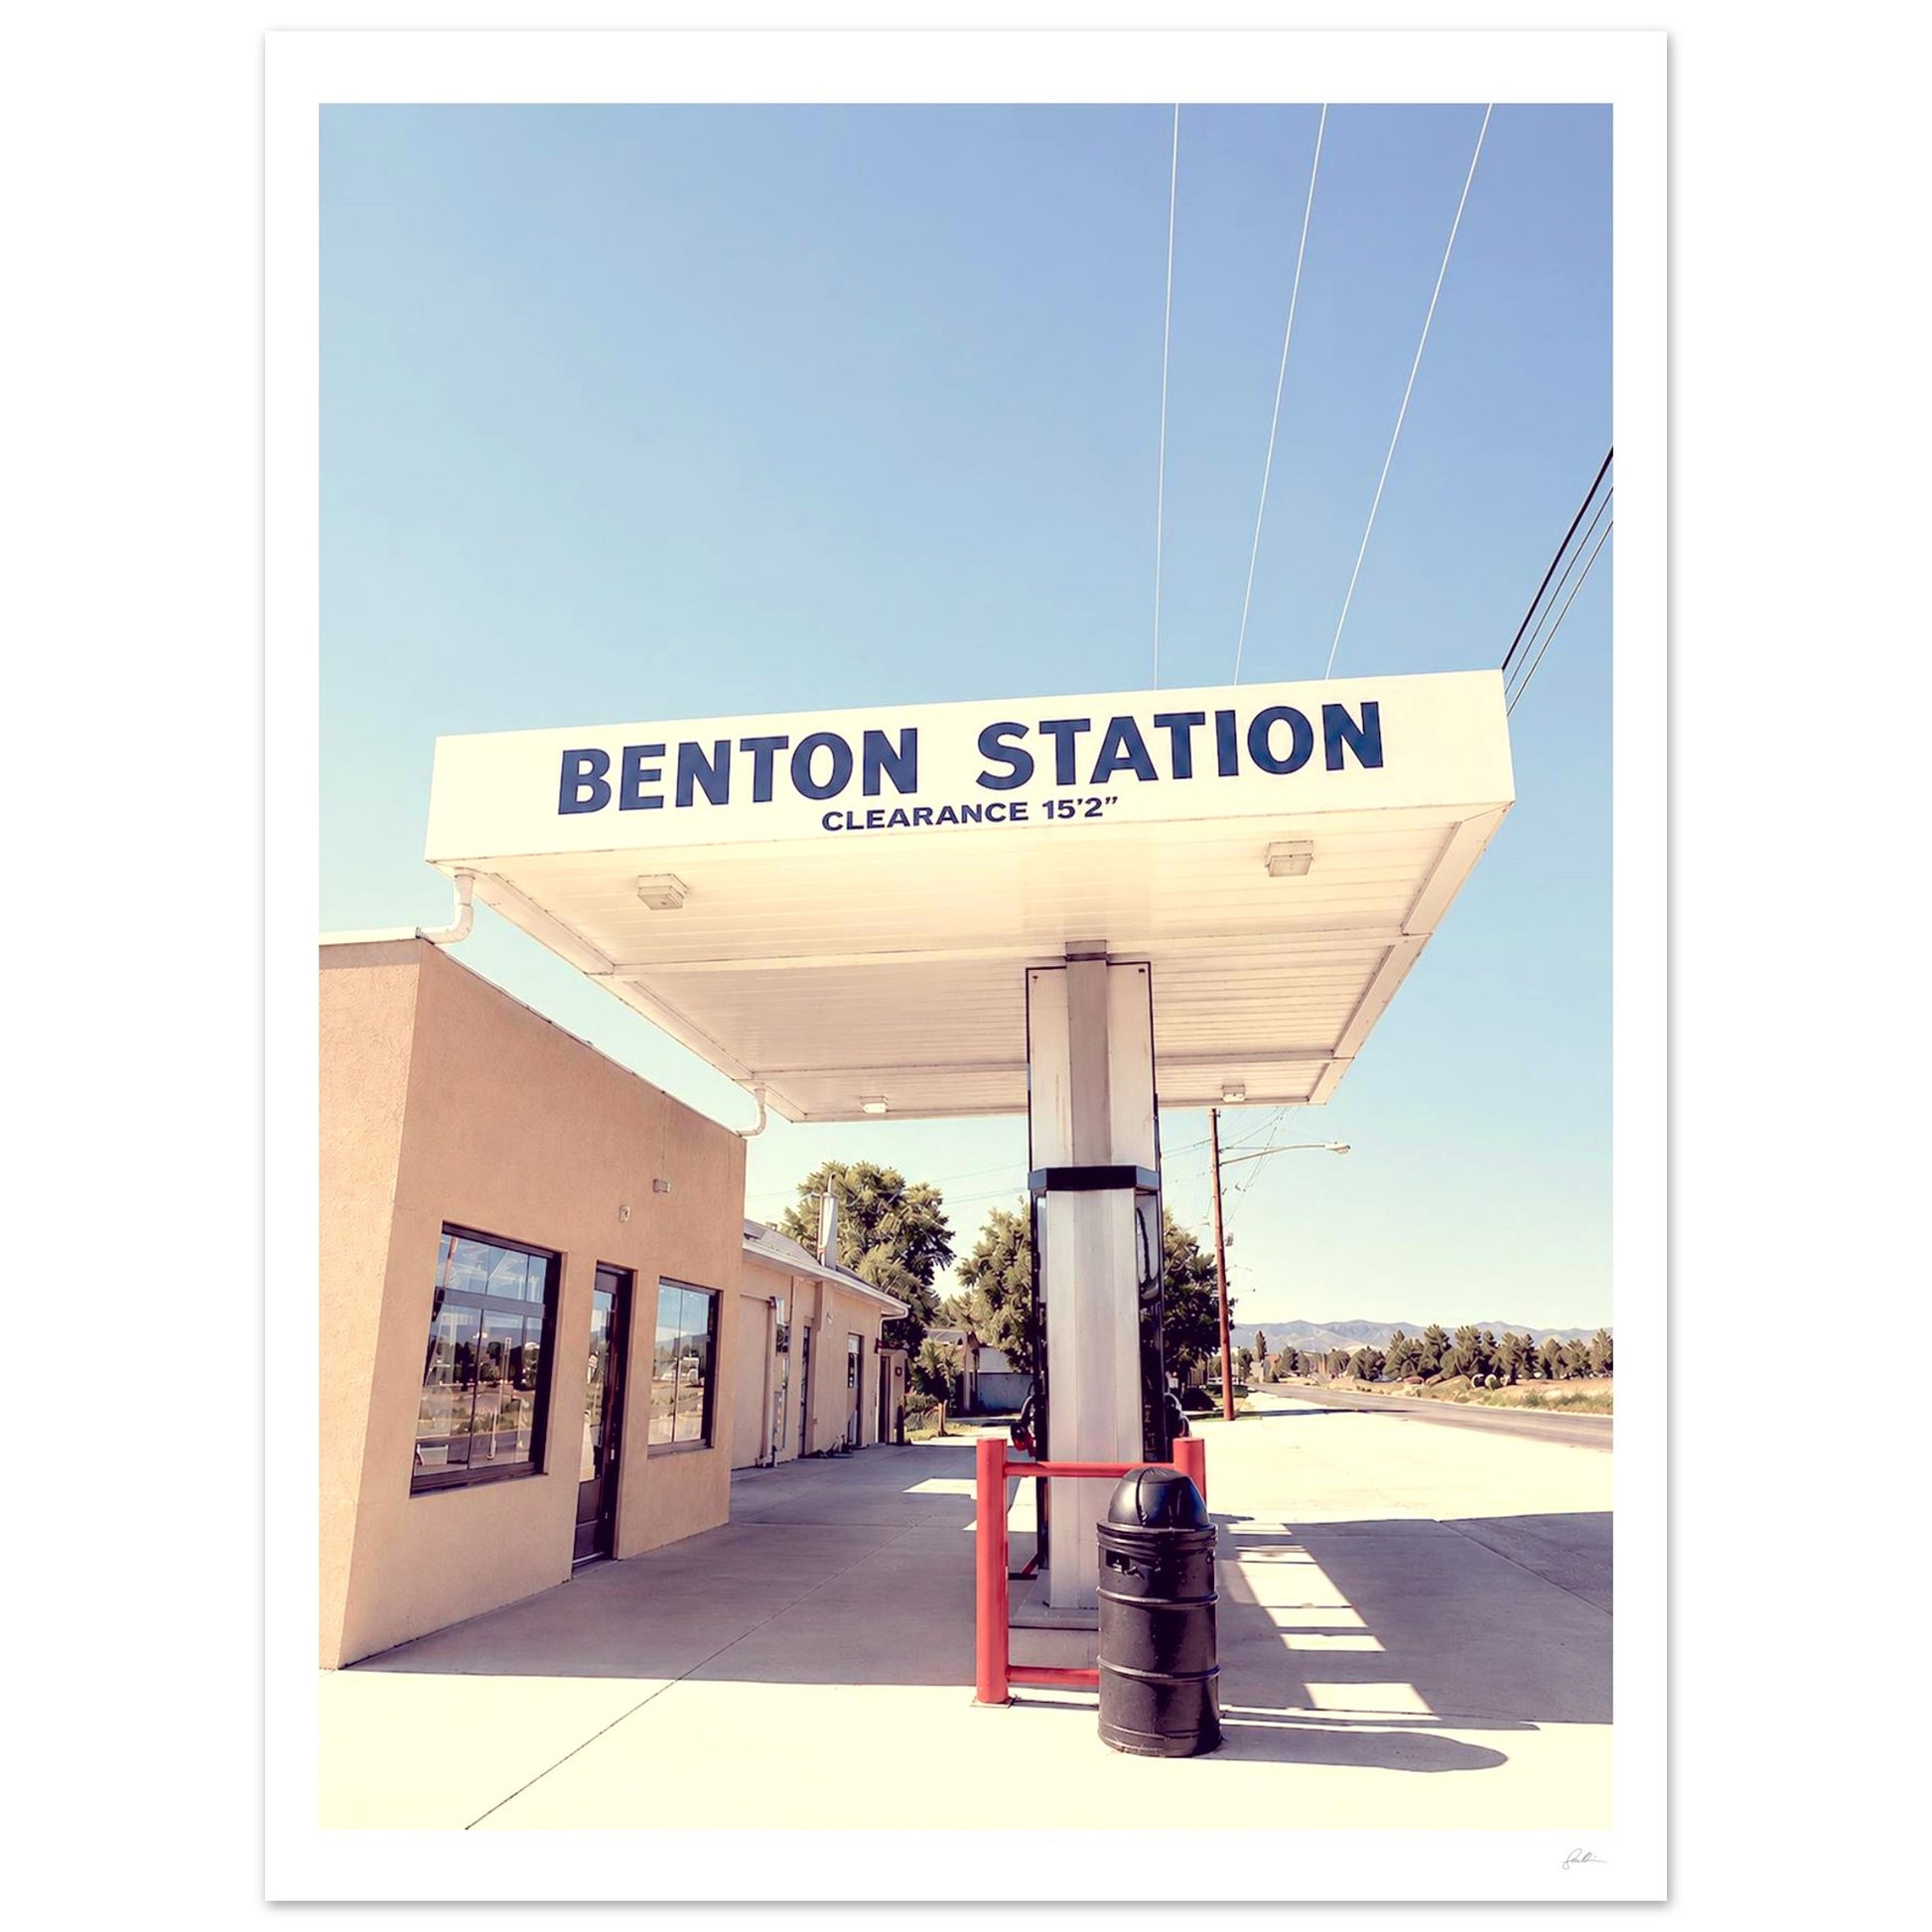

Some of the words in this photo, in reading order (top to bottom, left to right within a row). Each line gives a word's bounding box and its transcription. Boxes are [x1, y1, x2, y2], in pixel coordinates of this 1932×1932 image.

[557, 727, 918, 816] BENTON
[975, 701, 1384, 791] STATION
[821, 802, 1030, 832] CLEARANCE
